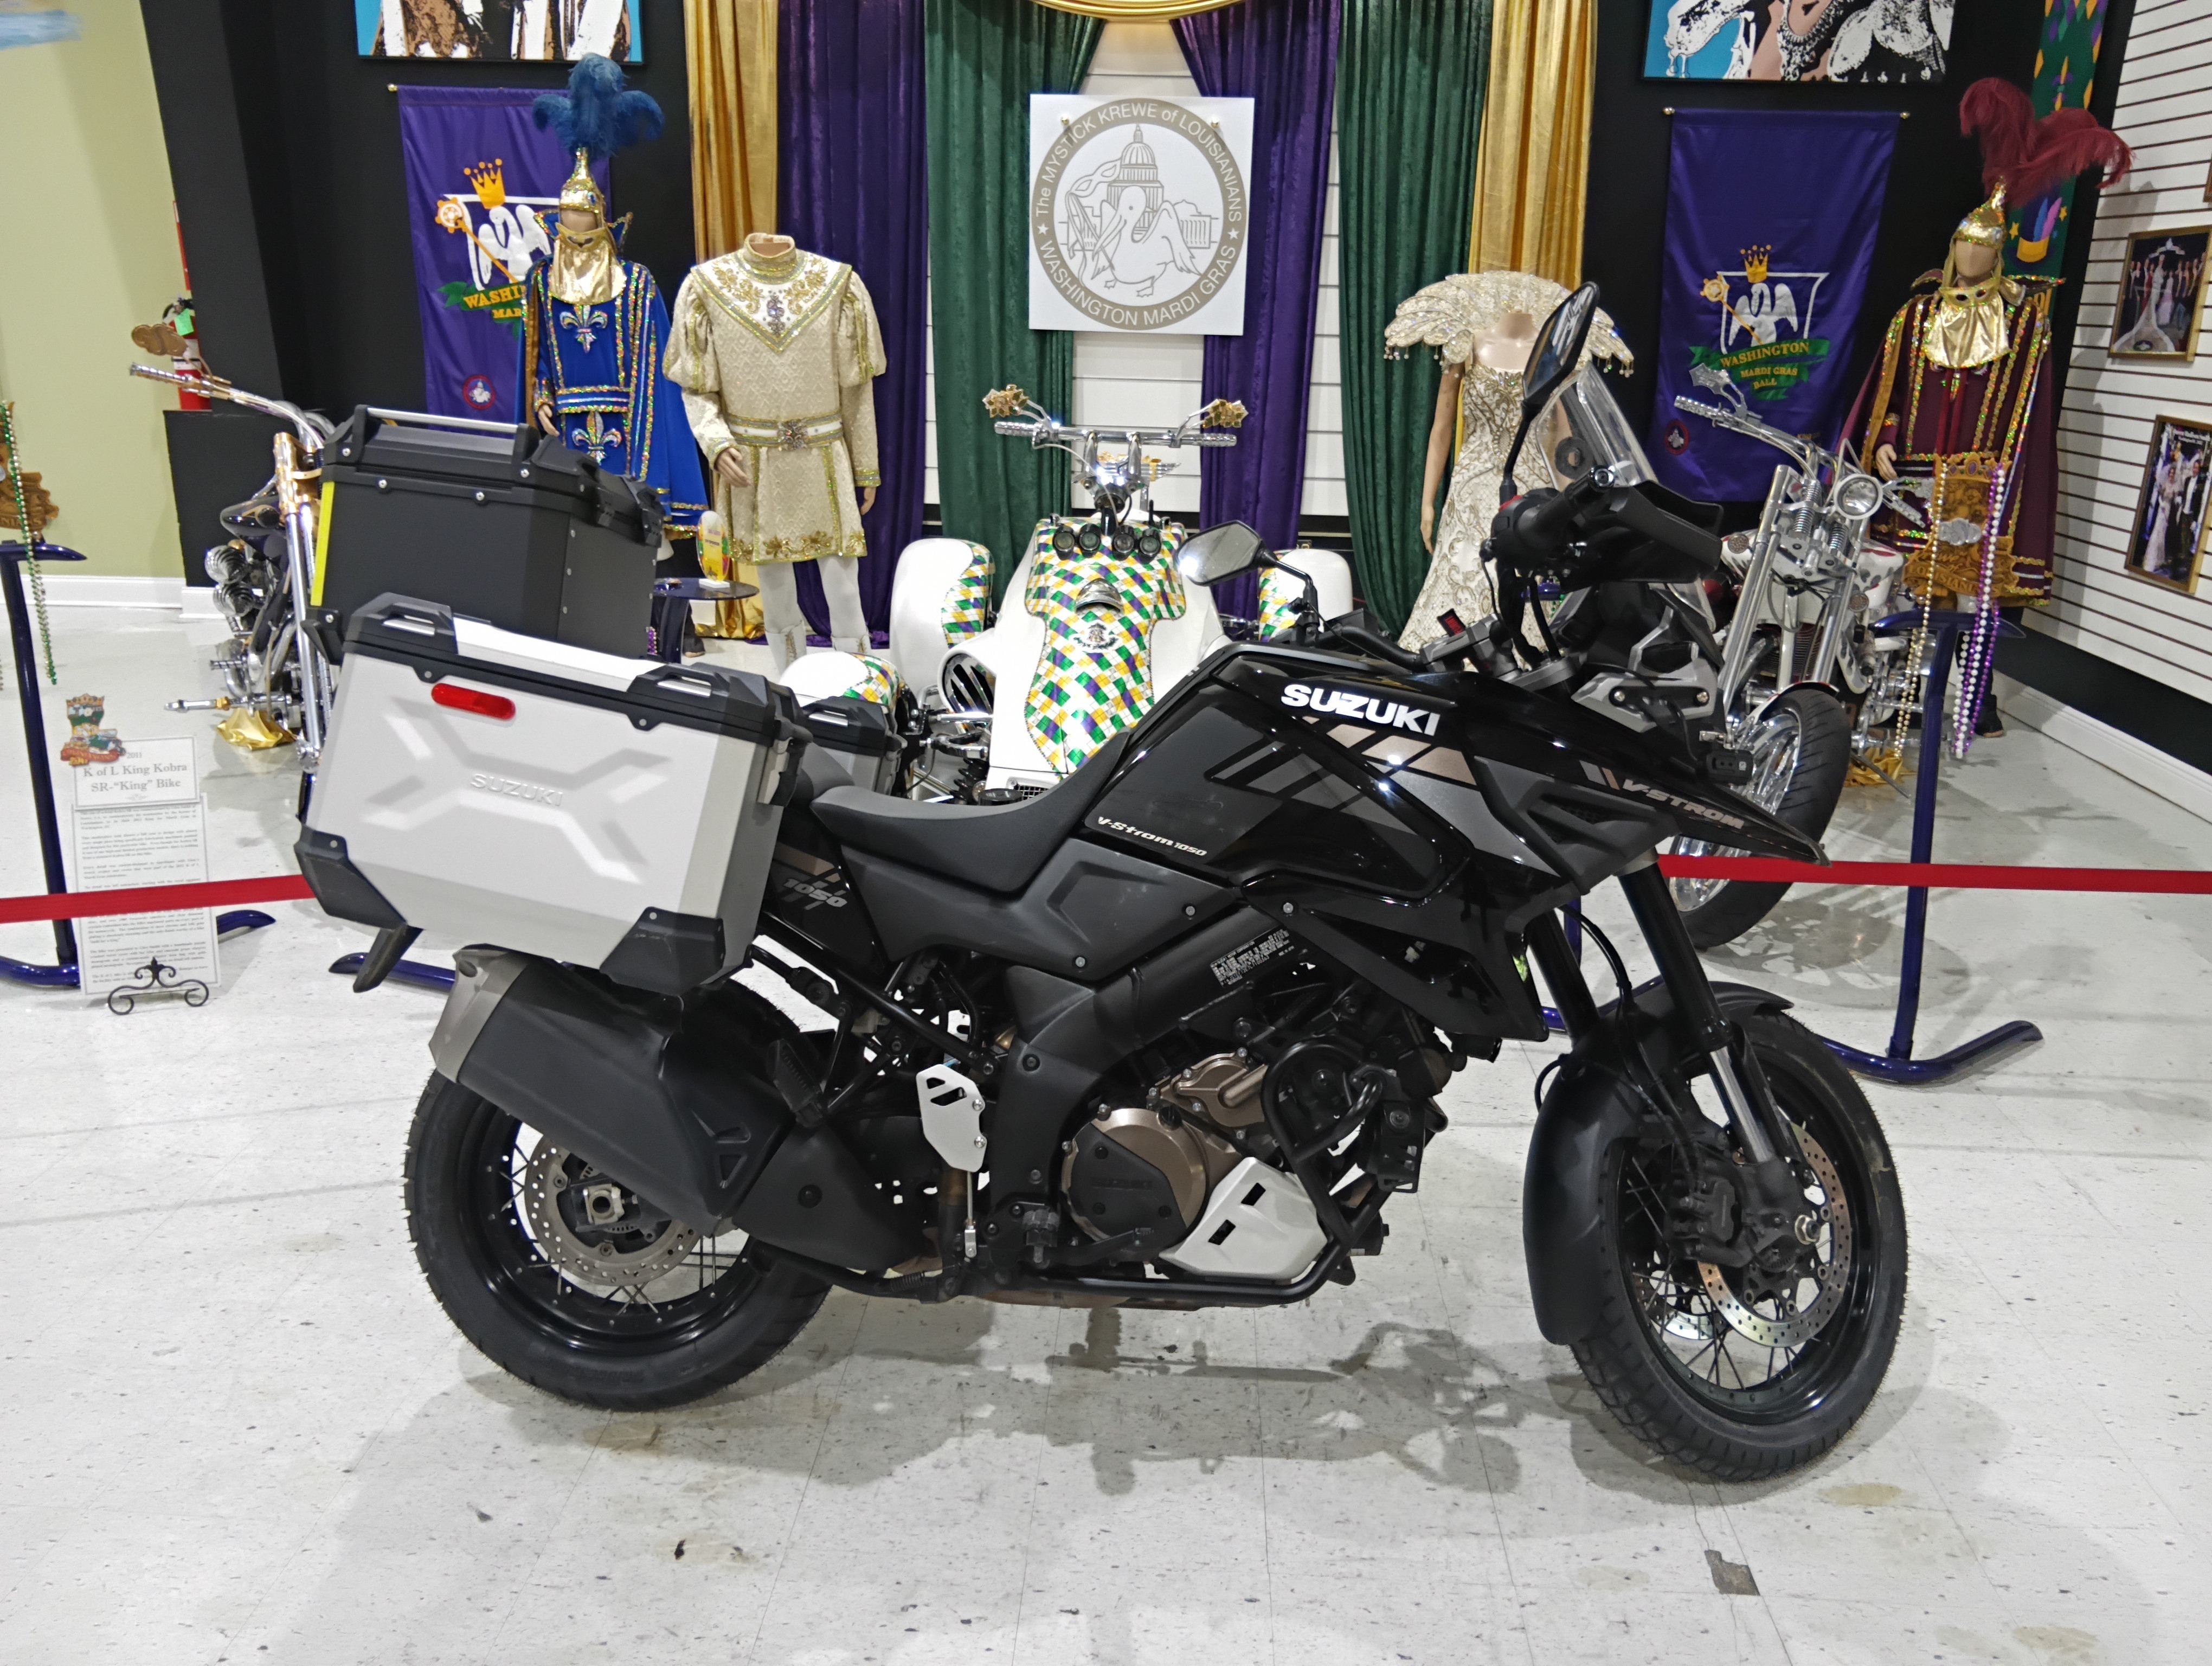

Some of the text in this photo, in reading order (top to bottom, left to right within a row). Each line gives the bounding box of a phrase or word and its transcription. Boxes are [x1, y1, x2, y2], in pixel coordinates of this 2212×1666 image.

[1036, 102, 1242, 222] The MYSTICK KREWE of LOUISIANIANS
[463, 285, 525, 309] WASHI
[1040, 240, 1236, 325] WASHINGTON MARDI GRAS
[1720, 342, 1810, 368] WASHINGTON
[1740, 366, 1798, 377] MARDI GRAS
[1753, 378, 1778, 389] BALL
[1281, 683, 1441, 736] SUZUKI
[83, 763, 188, 777] K of L King Kobra
[156, 778, 181, 788] Bike
[470, 772, 564, 806] SUZUKI
[1623, 779, 1745, 829] V-STROM
[1097, 816, 1208, 857] V-Strom 1050
[783, 877, 847, 908] 1050
